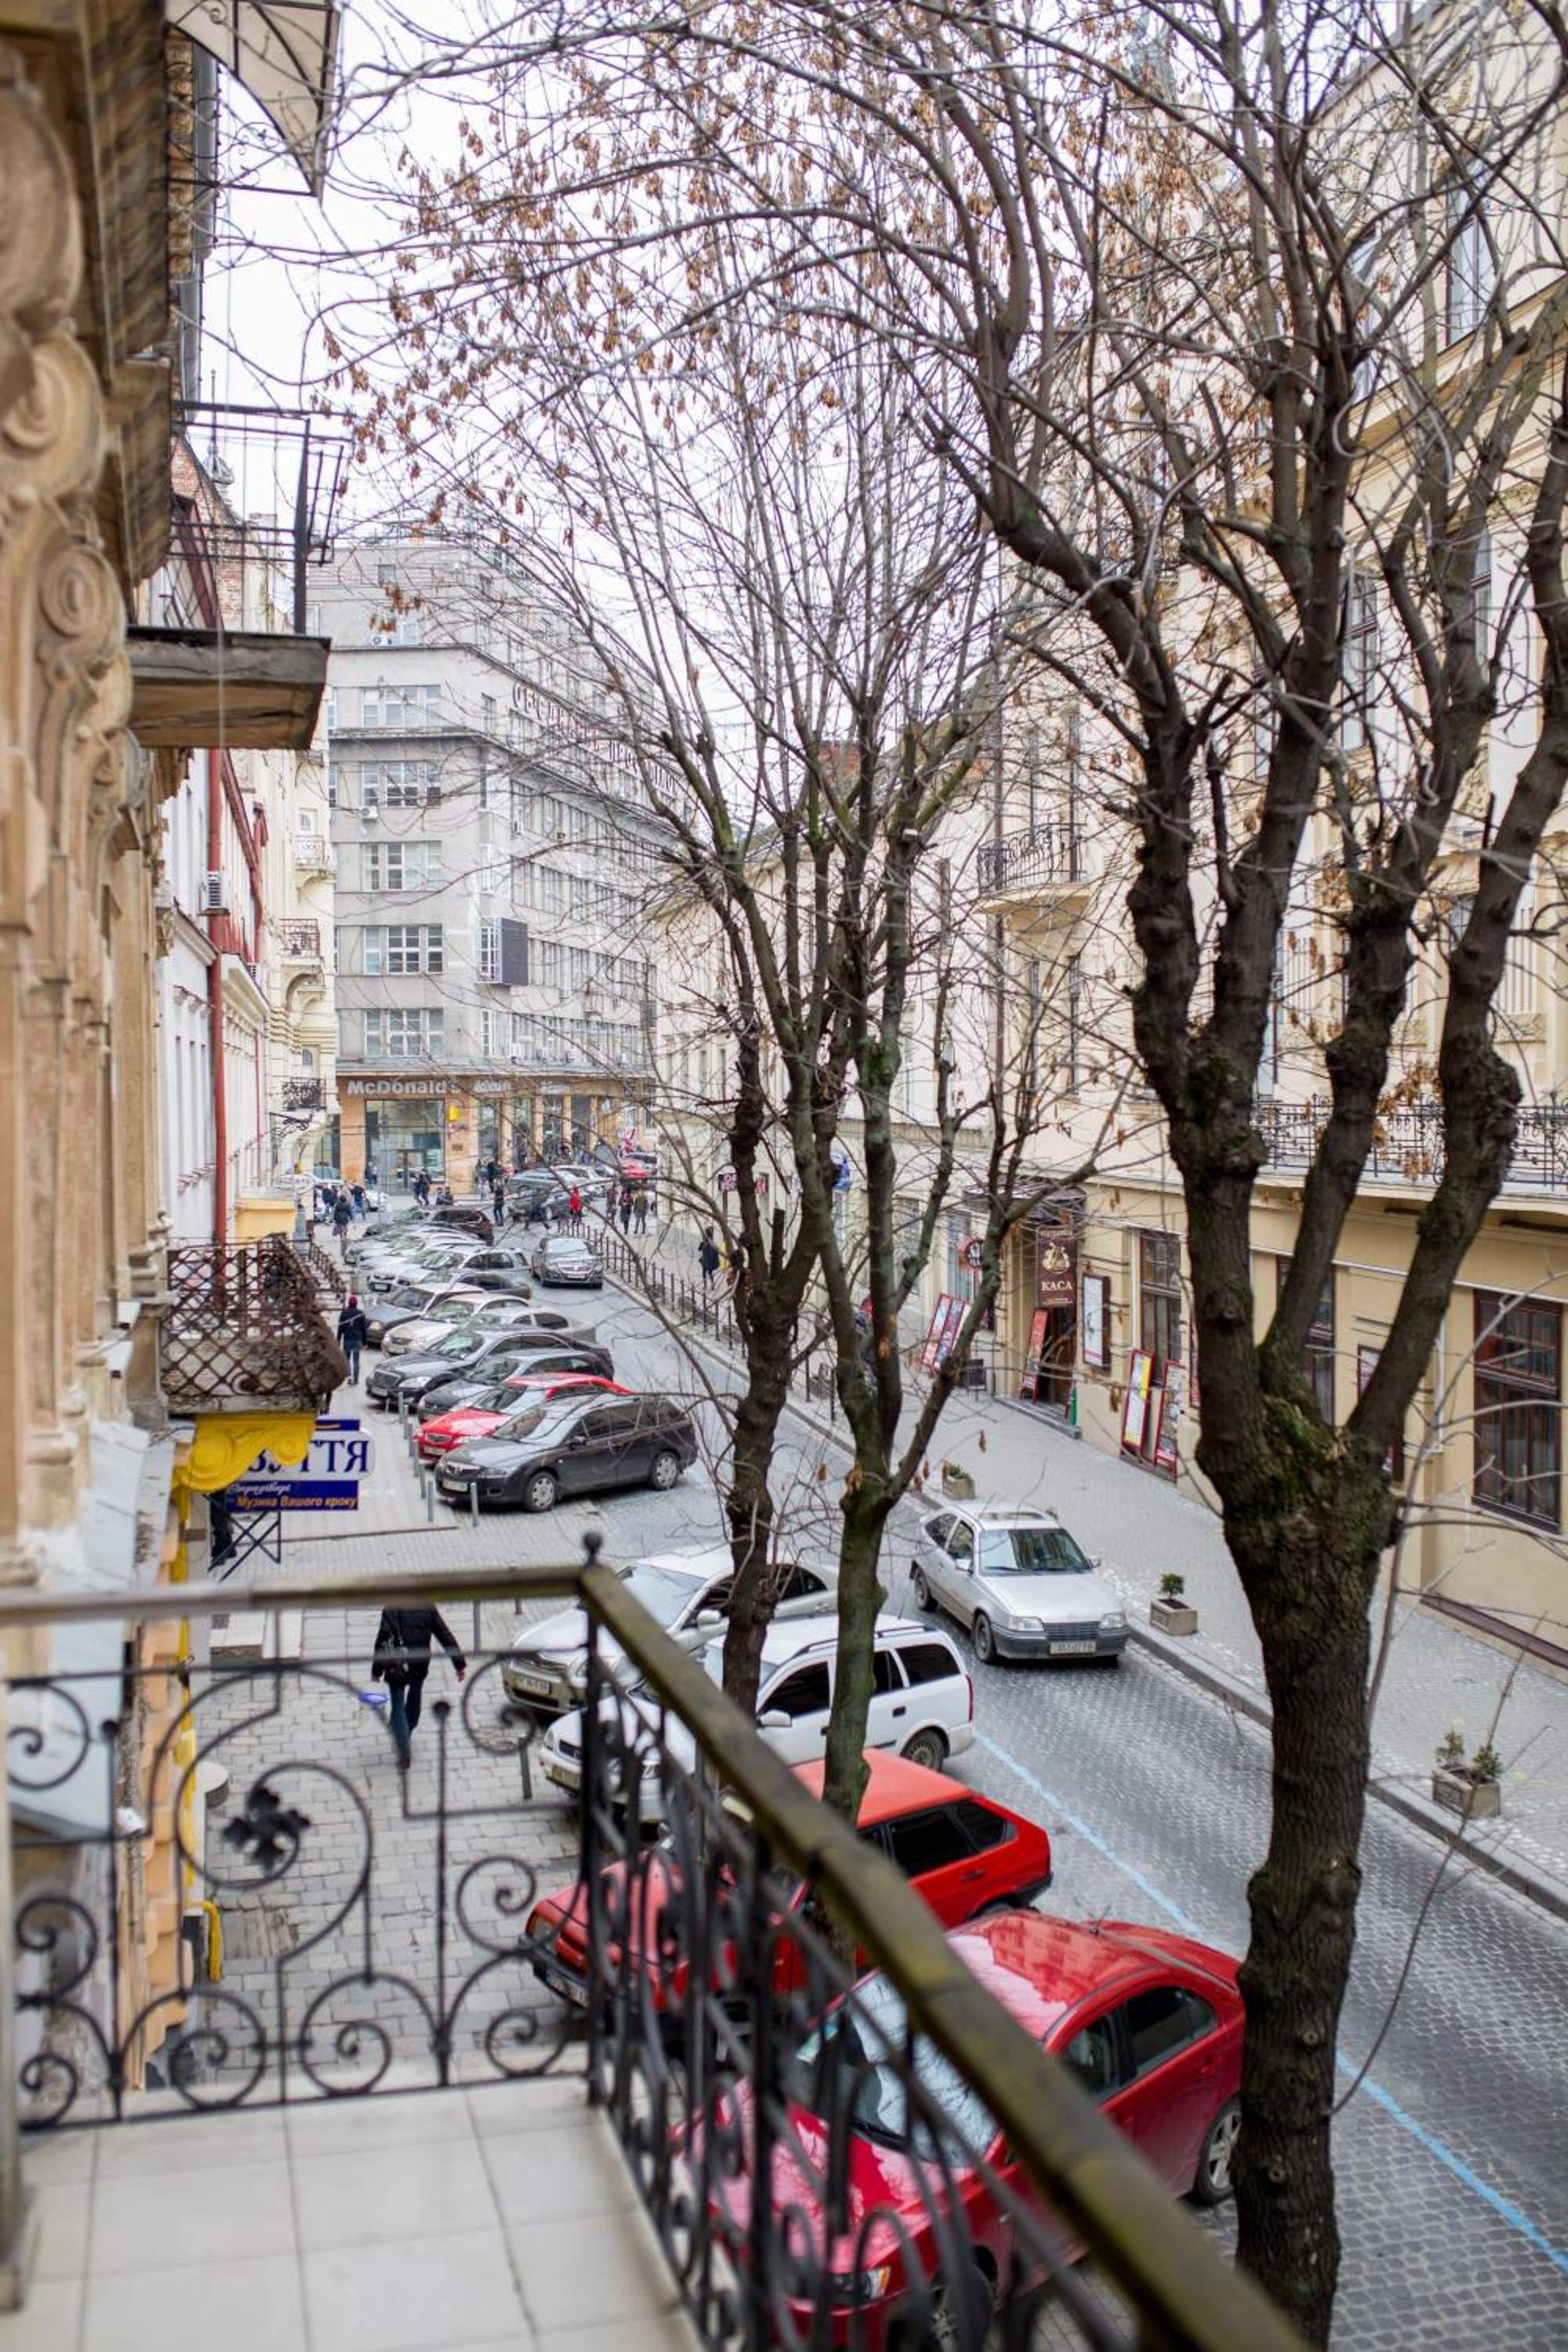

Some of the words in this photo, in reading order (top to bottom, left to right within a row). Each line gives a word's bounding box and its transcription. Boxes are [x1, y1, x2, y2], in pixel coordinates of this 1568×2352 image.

[347, 1078, 463, 1094] McDonald's
[1041, 1280, 1073, 1291] КАСА
[238, 1496, 277, 1510] Музика
[280, 1495, 323, 1506] Вашого
